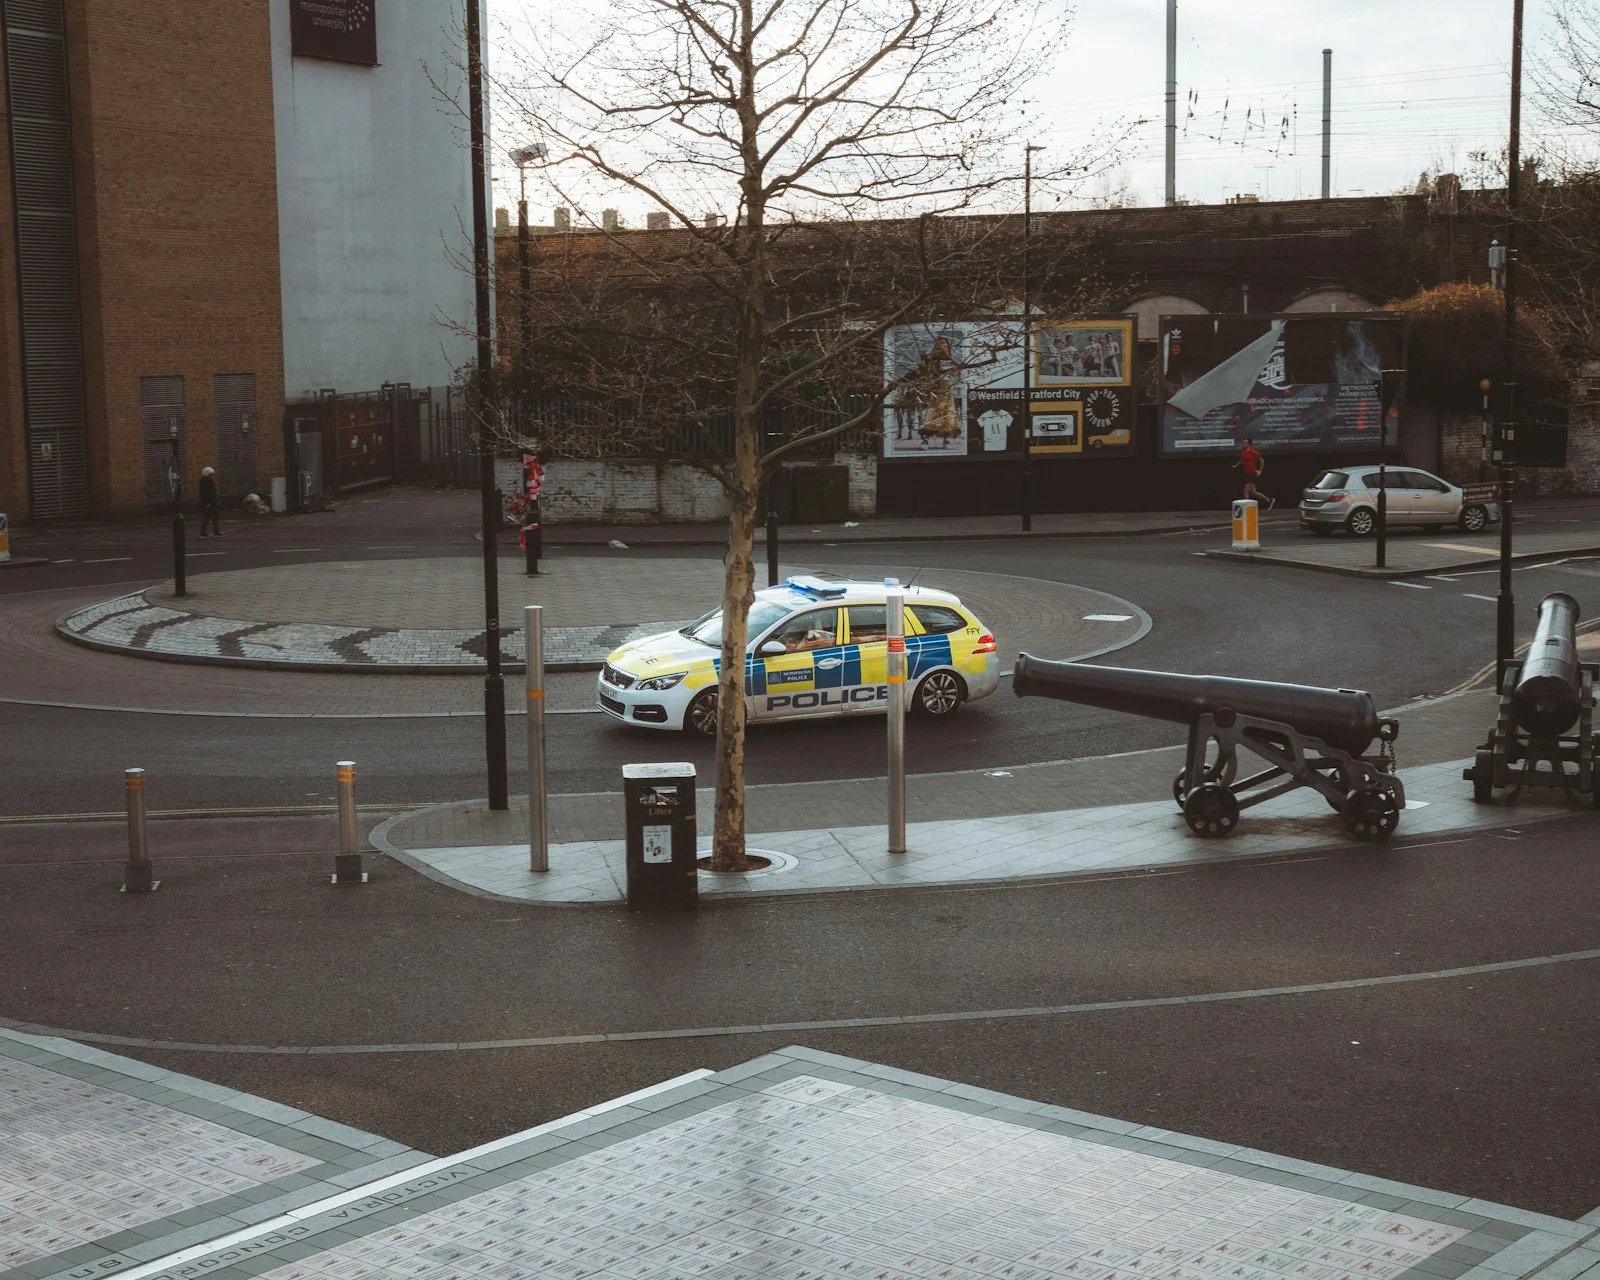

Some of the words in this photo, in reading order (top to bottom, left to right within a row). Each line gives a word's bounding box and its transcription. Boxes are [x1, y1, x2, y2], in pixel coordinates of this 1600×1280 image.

[301, 2, 347, 16] metropolitan
[312, 16, 347, 32] university
[968, 390, 1019, 400] @Westfield
[1019, 389, 1061, 400] Sratford
[1063, 388, 1081, 400] City
[966, 627, 980, 636] FFY
[766, 685, 888, 711] POLICE
[648, 807, 673, 816] Litter
[329, 1171, 469, 1218] VICTORIA
